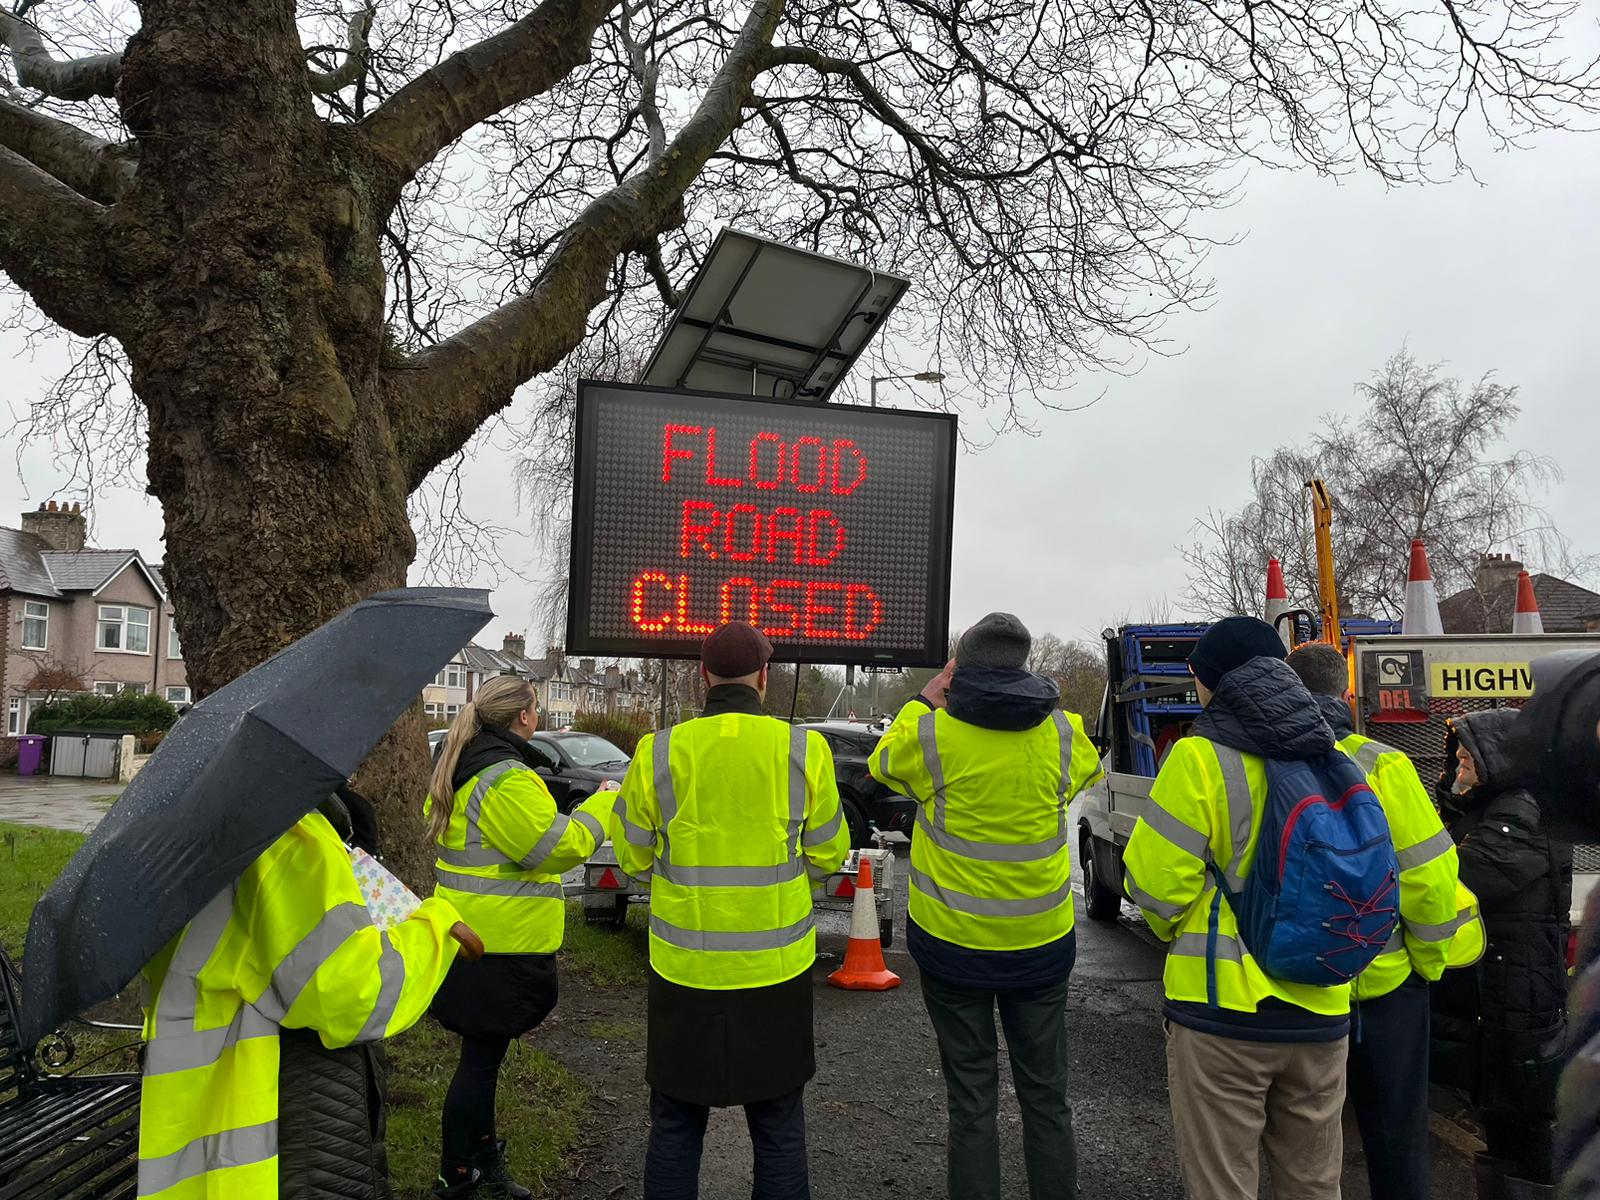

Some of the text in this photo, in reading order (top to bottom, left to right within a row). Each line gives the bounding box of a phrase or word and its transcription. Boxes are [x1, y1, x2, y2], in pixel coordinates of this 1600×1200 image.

[661, 423, 868, 496] FLOOD
[679, 499, 846, 566] ROAD
[630, 569, 883, 640] CLOSED
